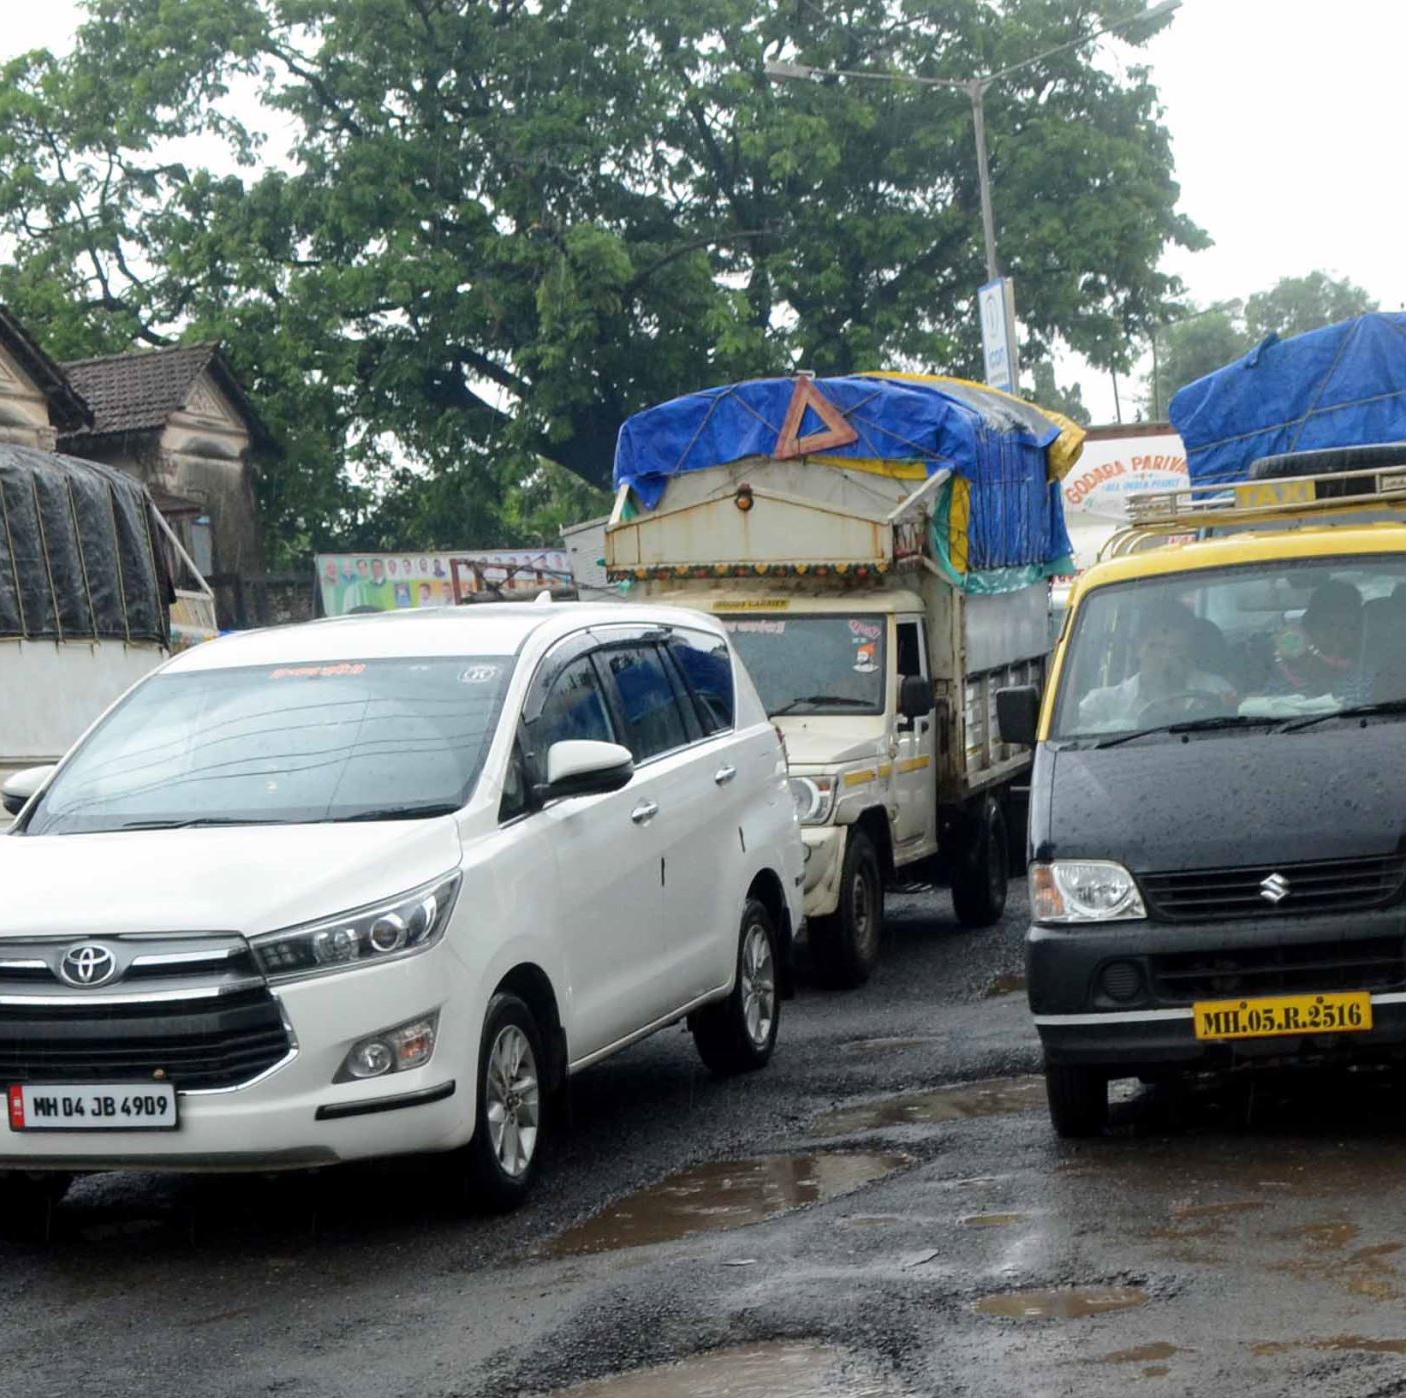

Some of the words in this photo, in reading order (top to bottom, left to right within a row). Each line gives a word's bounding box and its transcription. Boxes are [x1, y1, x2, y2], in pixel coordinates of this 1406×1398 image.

[1065, 460, 1126, 505] GODARA
[1235, 480, 1315, 508] TAXI
[1203, 1002, 1362, 1035] MH.05.R.2516
[33, 1097, 58, 1117] MH
[62, 1097, 85, 1117] 04
[91, 1097, 116, 1117] JB
[121, 1096, 168, 1117] 4909
